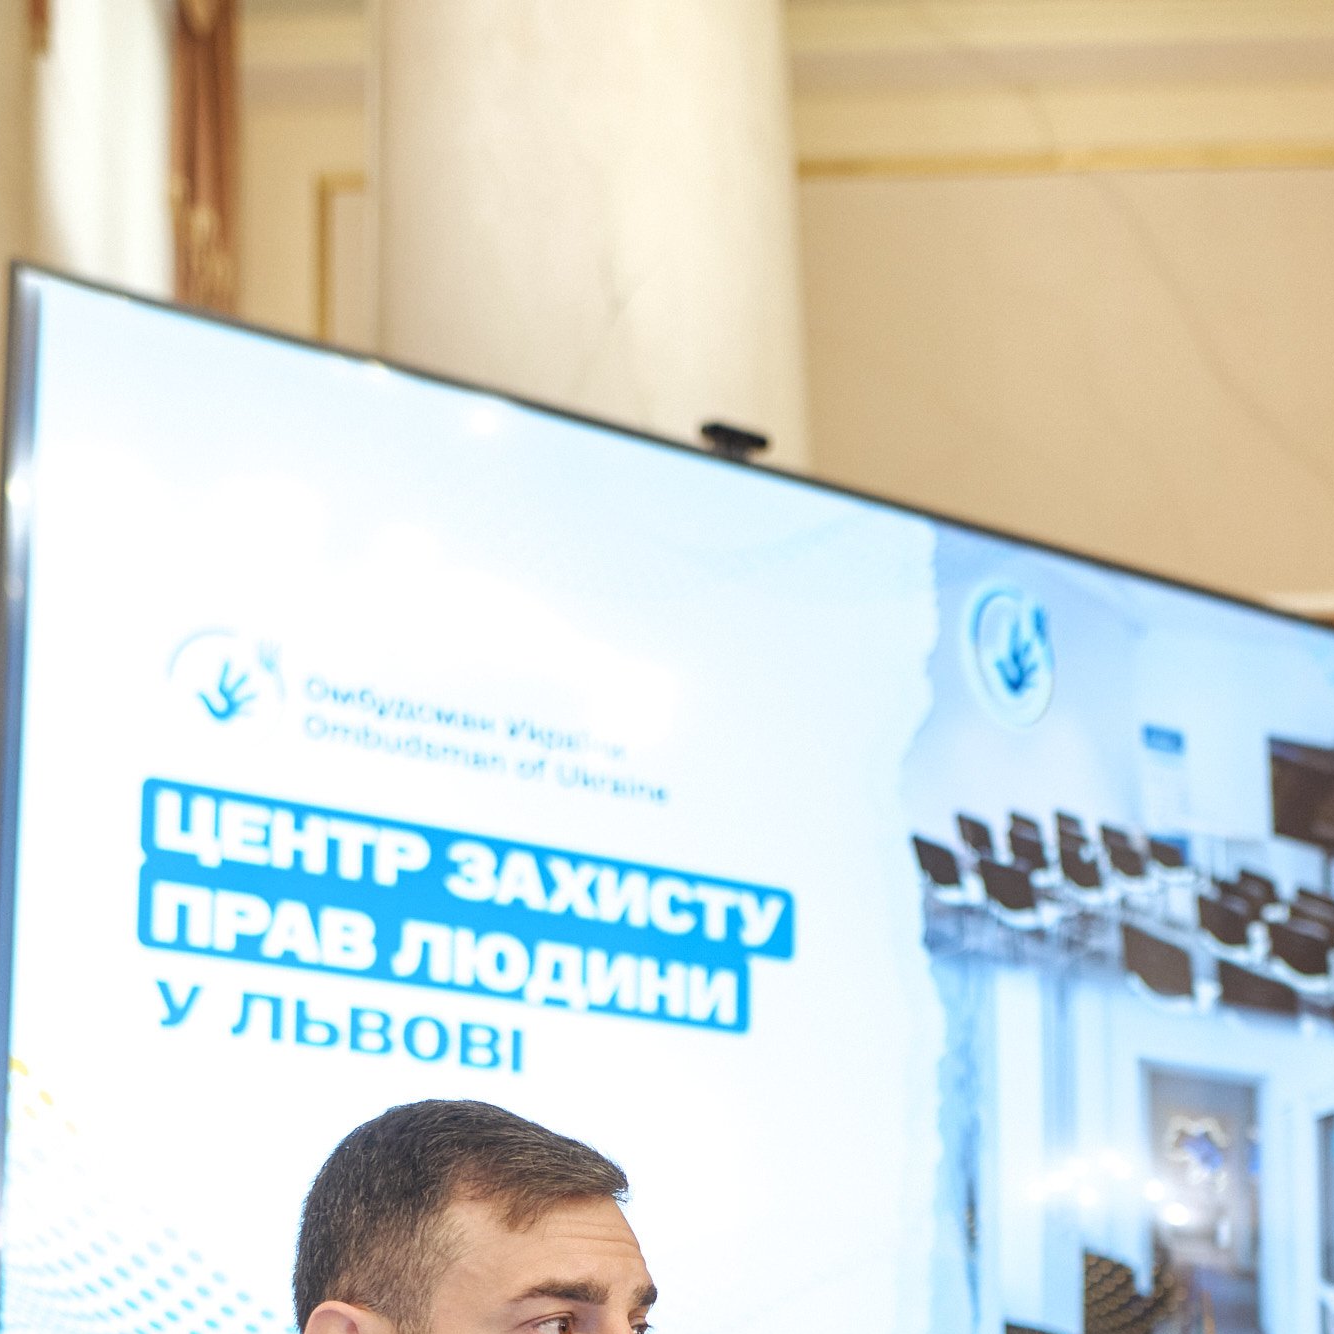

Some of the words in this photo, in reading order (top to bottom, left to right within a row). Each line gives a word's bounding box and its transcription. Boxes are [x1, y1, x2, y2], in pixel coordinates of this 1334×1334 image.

[303, 711, 505, 772] Ombudsman
[515, 753, 546, 783] of
[153, 788, 431, 886] ЦЕНТР
[445, 842, 785, 946] ЗАХИСТУ
[151, 883, 378, 970] ПРАВ
[392, 920, 739, 1026] ЛЮДИНИ
[156, 980, 200, 1027] У
[231, 994, 523, 1073] ЛЬВОВІ
